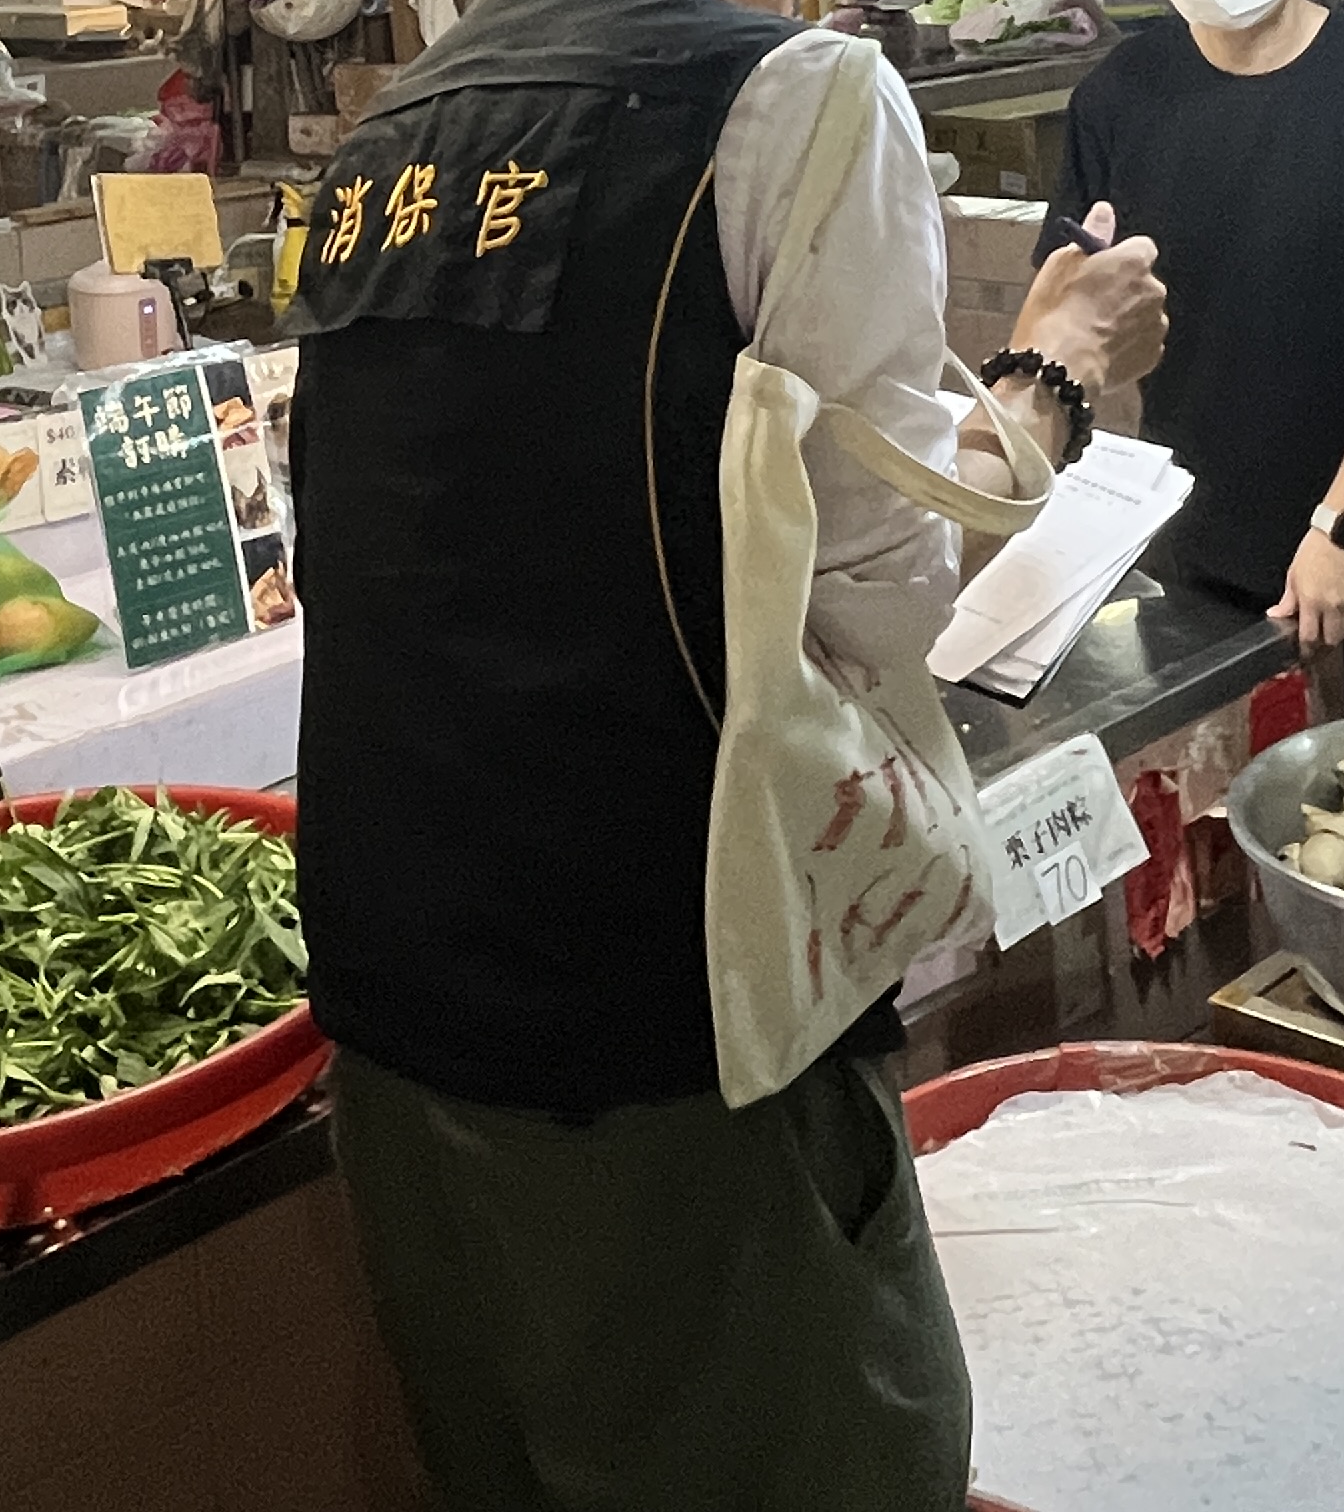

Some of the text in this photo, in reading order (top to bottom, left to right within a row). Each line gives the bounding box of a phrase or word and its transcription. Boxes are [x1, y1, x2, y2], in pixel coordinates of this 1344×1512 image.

[320, 159, 550, 265] 消保官
[1040, 854, 1088, 915] 70
